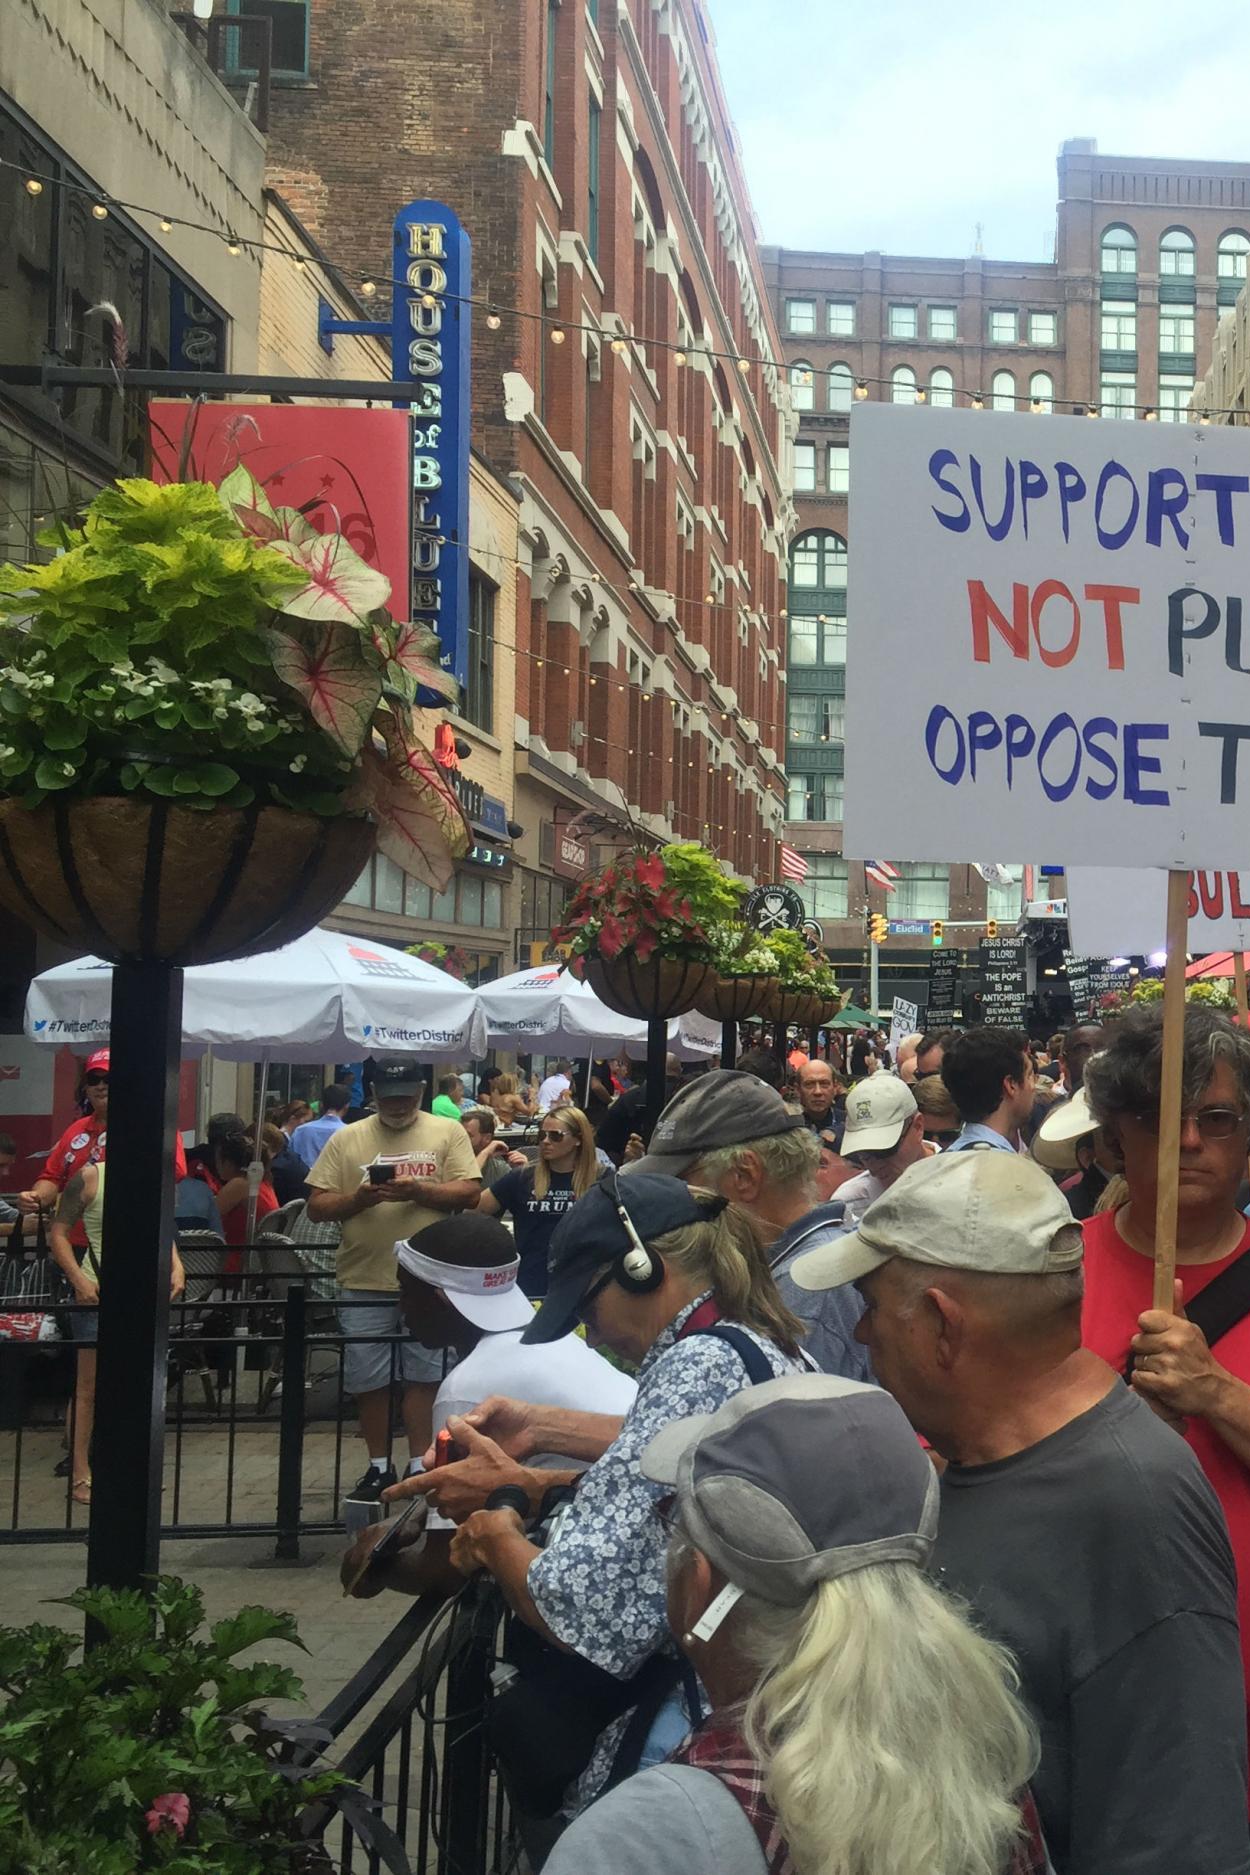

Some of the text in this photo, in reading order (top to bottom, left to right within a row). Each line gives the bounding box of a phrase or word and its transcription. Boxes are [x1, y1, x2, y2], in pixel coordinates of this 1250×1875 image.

[929, 449, 1249, 550] SUPPORT
[414, 456, 441, 636] BLUE
[967, 579, 1140, 670] NOT
[925, 705, 1170, 806] OPPOSE
[896, 924, 924, 933] Euclid
[981, 938, 1025, 947] JESUS CHRIST
[989, 950, 996, 959] IS
[985, 973, 1022, 981] THE POPE
[994, 983, 1003, 991] IS
[982, 993, 1026, 1002] ANTICHRIST
[986, 1007, 1021, 1015] BEWARE
[984, 1016, 1023, 1024] OF FALSE
